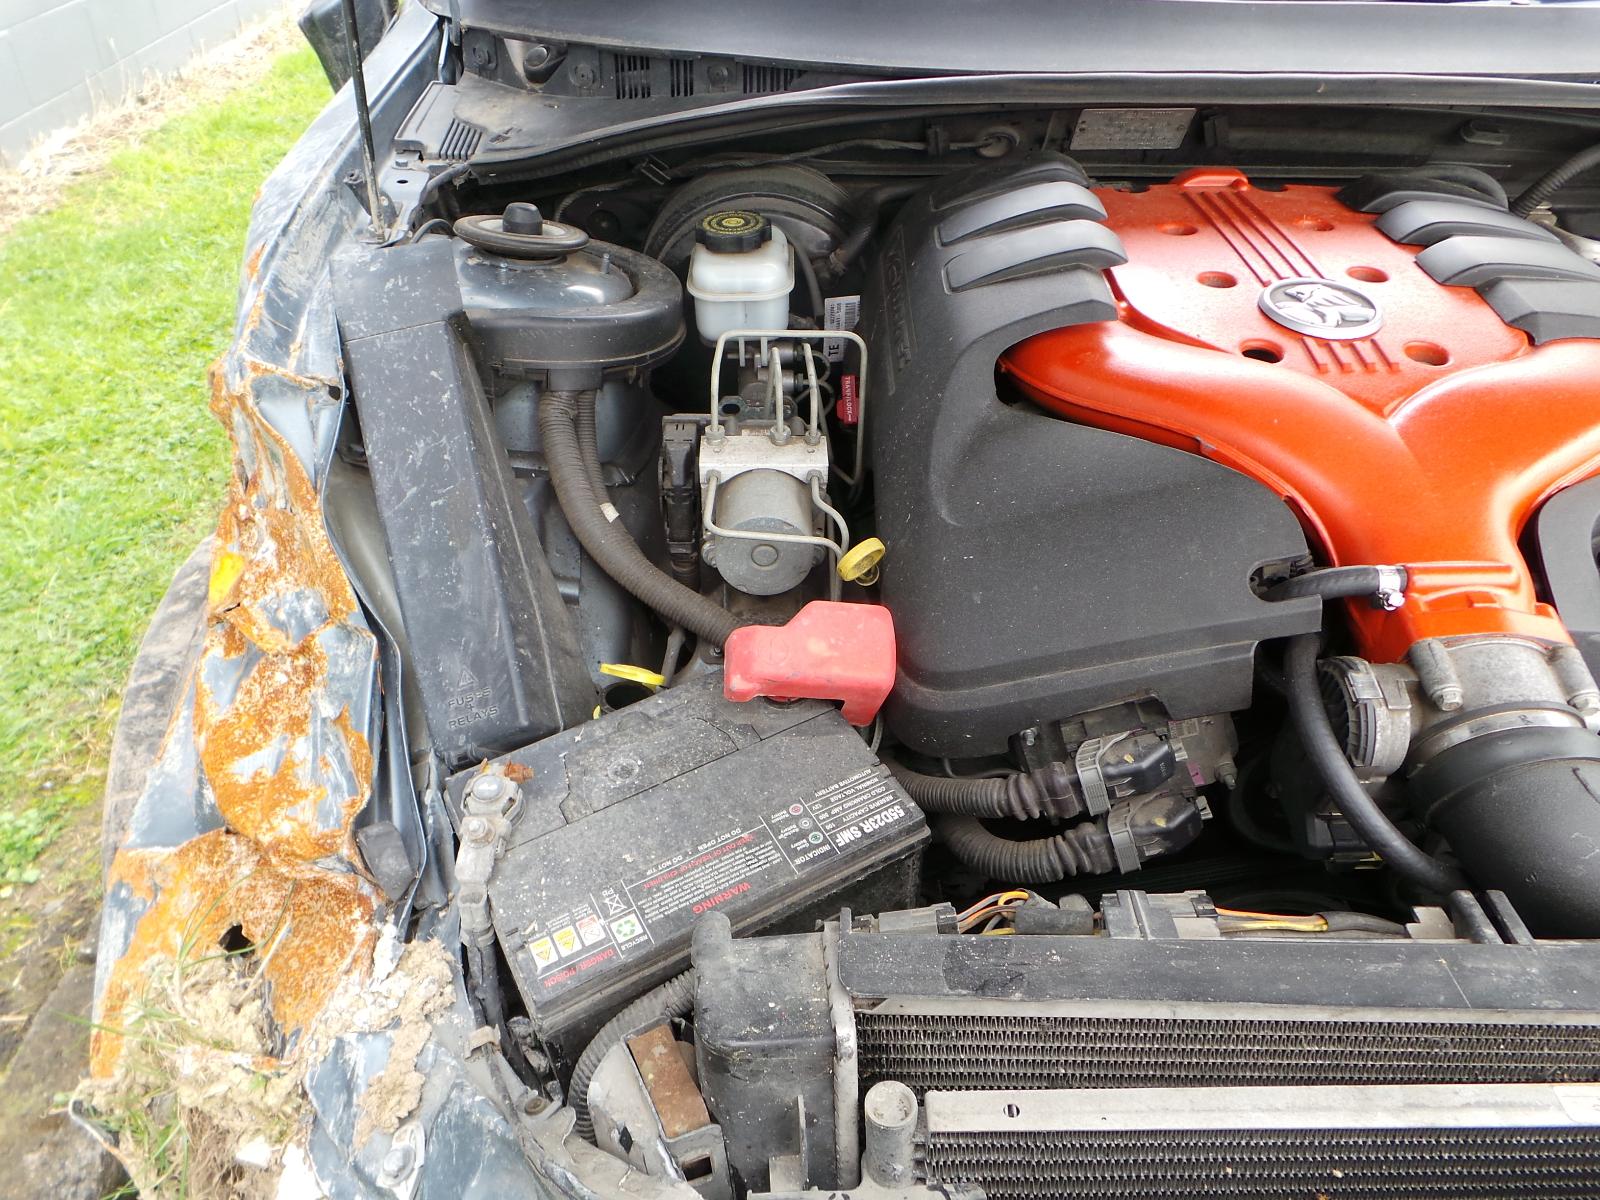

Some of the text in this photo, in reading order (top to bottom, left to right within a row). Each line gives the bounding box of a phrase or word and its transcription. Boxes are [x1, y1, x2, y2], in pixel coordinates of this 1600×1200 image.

[828, 343, 840, 357] TE
[448, 705, 499, 728] RELAYS
[813, 767, 871, 797] AUTOMOTIVE BATTERY
[869, 785, 885, 796] COLD
[811, 776, 878, 810] NOMINAL VOLTAGE 12V
[842, 792, 870, 809] CRANKING
[868, 793, 893, 809] RESERVE
[829, 805, 842, 815] AMP
[841, 805, 869, 822] CAPACITY
[833, 803, 905, 847] 55D23R SMF
[696, 826, 741, 851] DO NOT OPEN
[720, 841, 736, 853] OUT
[645, 854, 682, 875] DO NOT TIP
[793, 843, 830, 865] INDICATOR
[601, 886, 614, 898] Pb
[690, 880, 751, 915] WARNING
[620, 933, 648, 951] RECYCLE
[577, 947, 615, 971] DANGER
[541, 965, 576, 989] POISON
